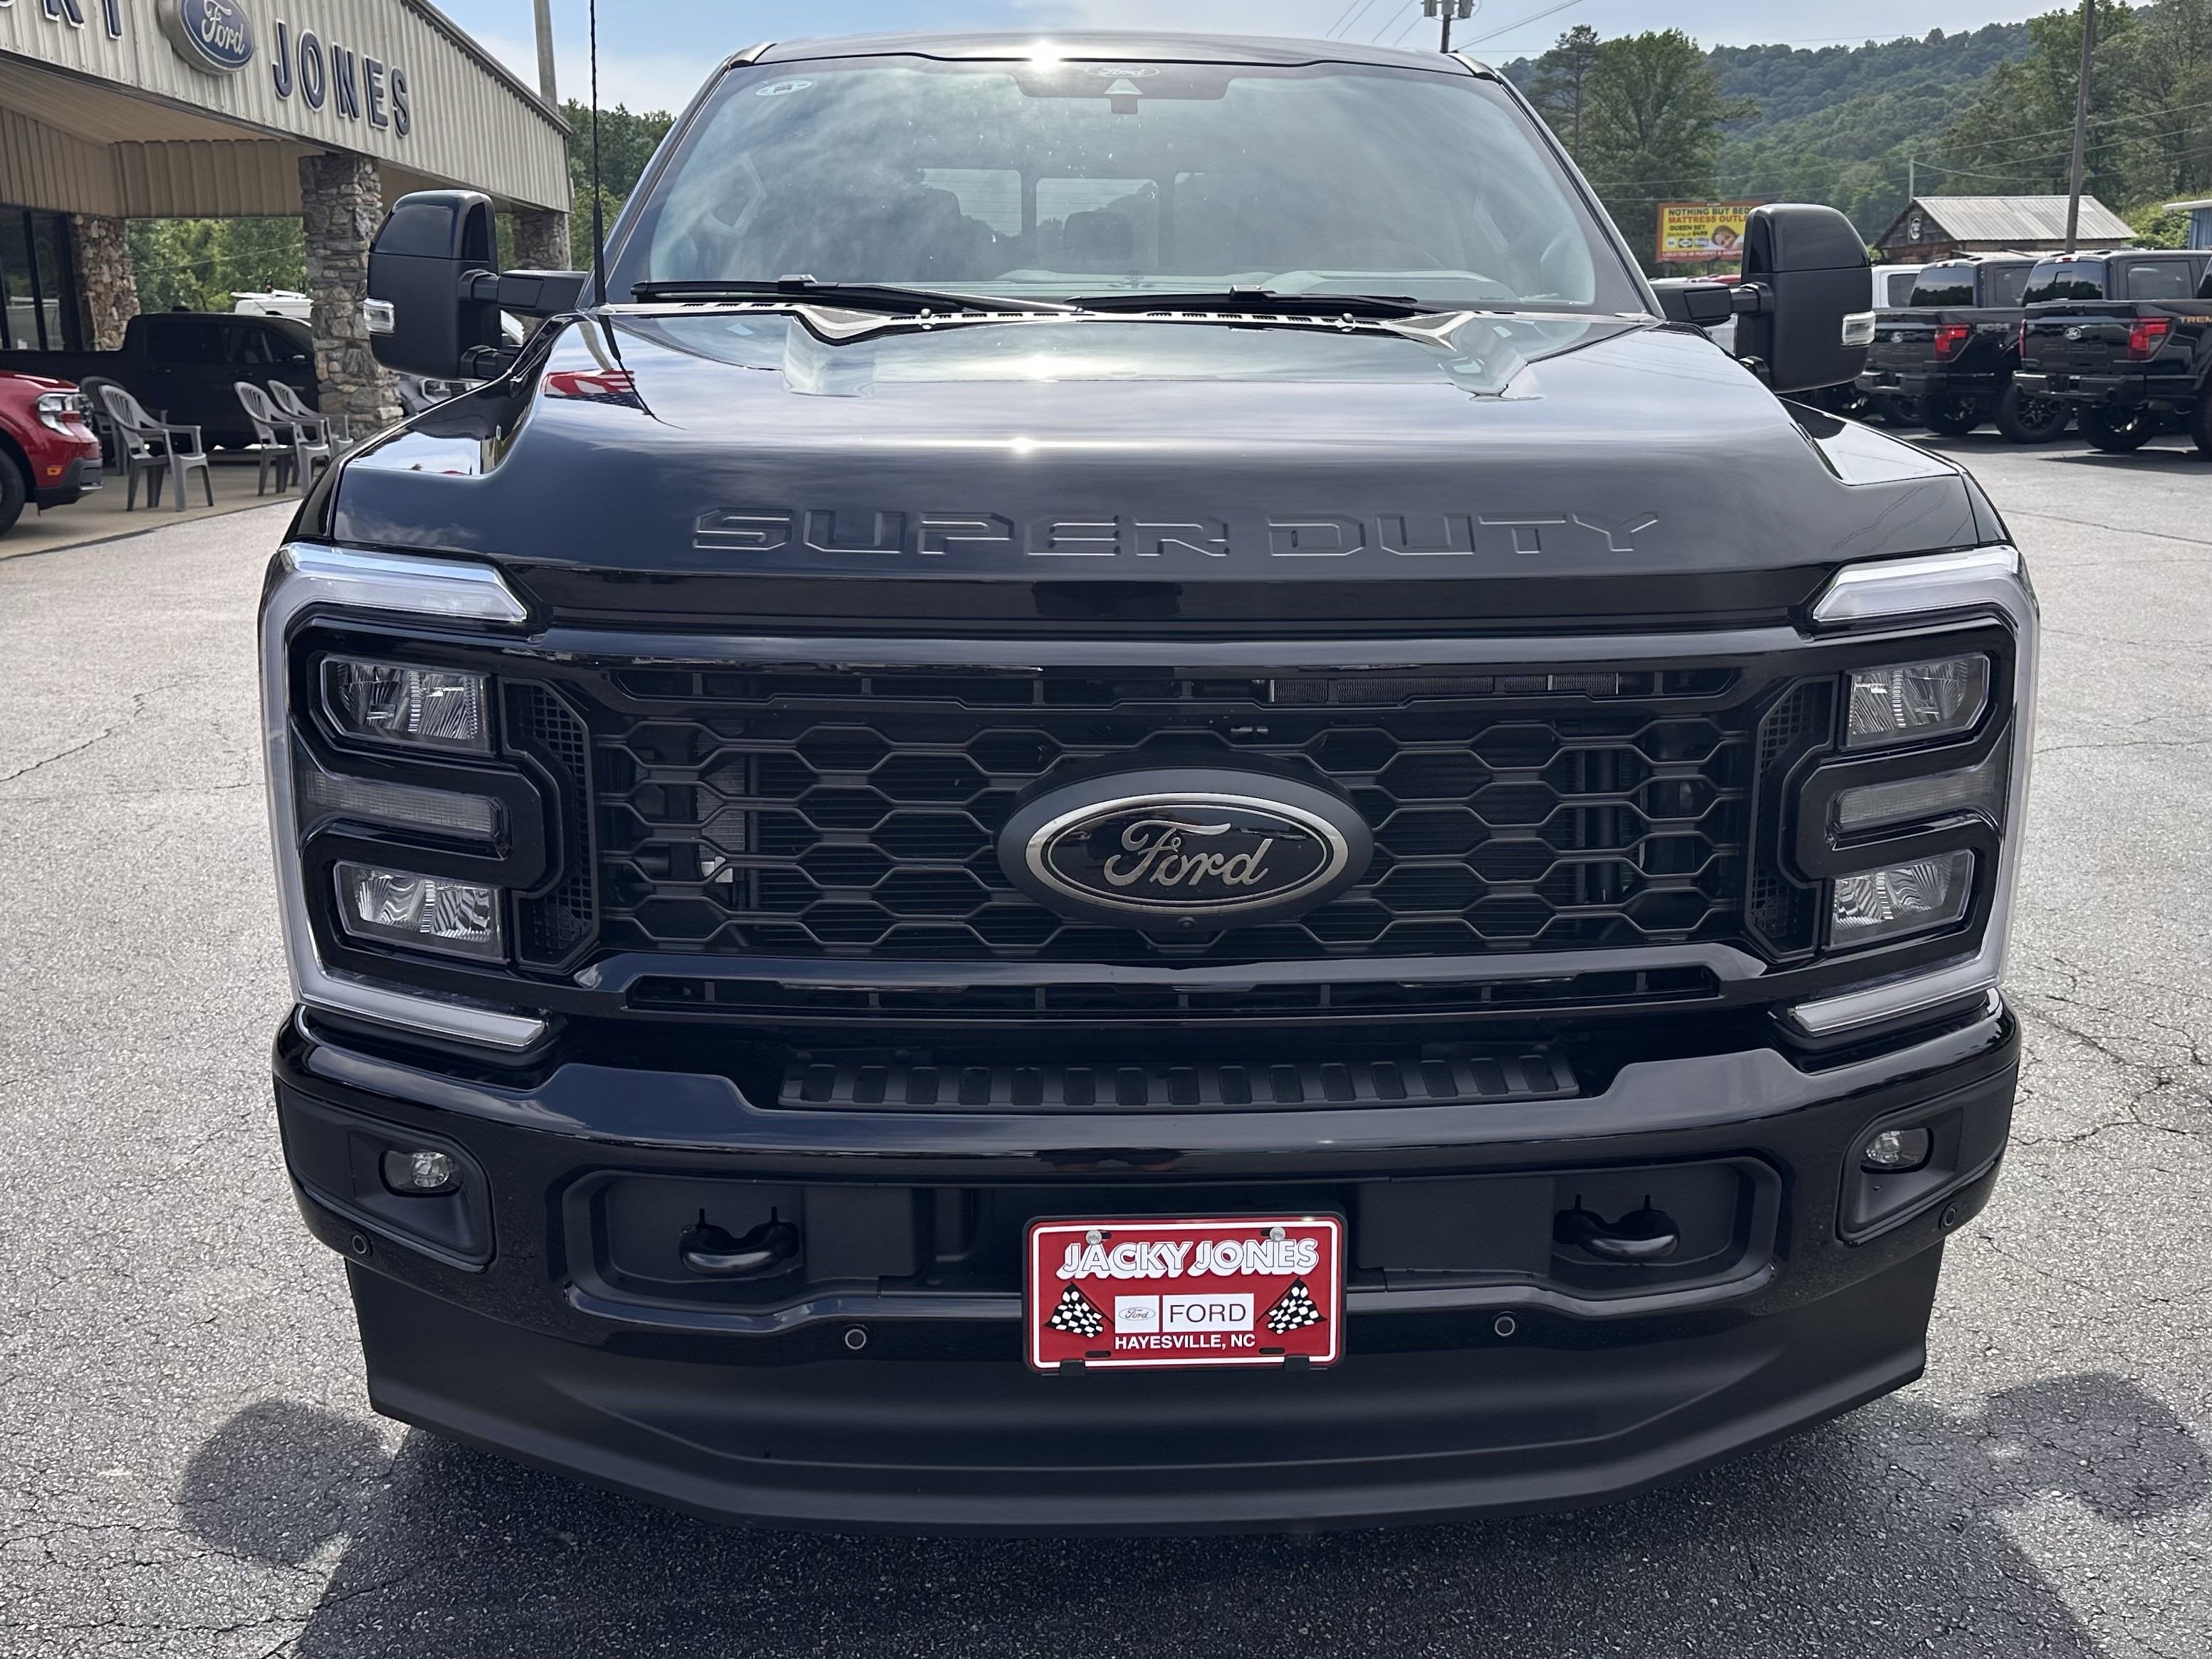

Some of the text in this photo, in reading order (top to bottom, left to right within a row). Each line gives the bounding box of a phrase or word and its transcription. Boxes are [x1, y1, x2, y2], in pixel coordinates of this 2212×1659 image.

[201, 0, 246, 56] Ford
[271, 19, 411, 138] JONES
[1097, 67, 1146, 76] Ford
[693, 507, 1659, 557] SUPER DUTY
[1102, 820, 1273, 886] Ford
[1055, 1237, 1320, 1280] JACKY JONES
[1125, 1303, 1246, 1323] Ford FORD
[1114, 1333, 1256, 1351] HAYESVILLE, NC
